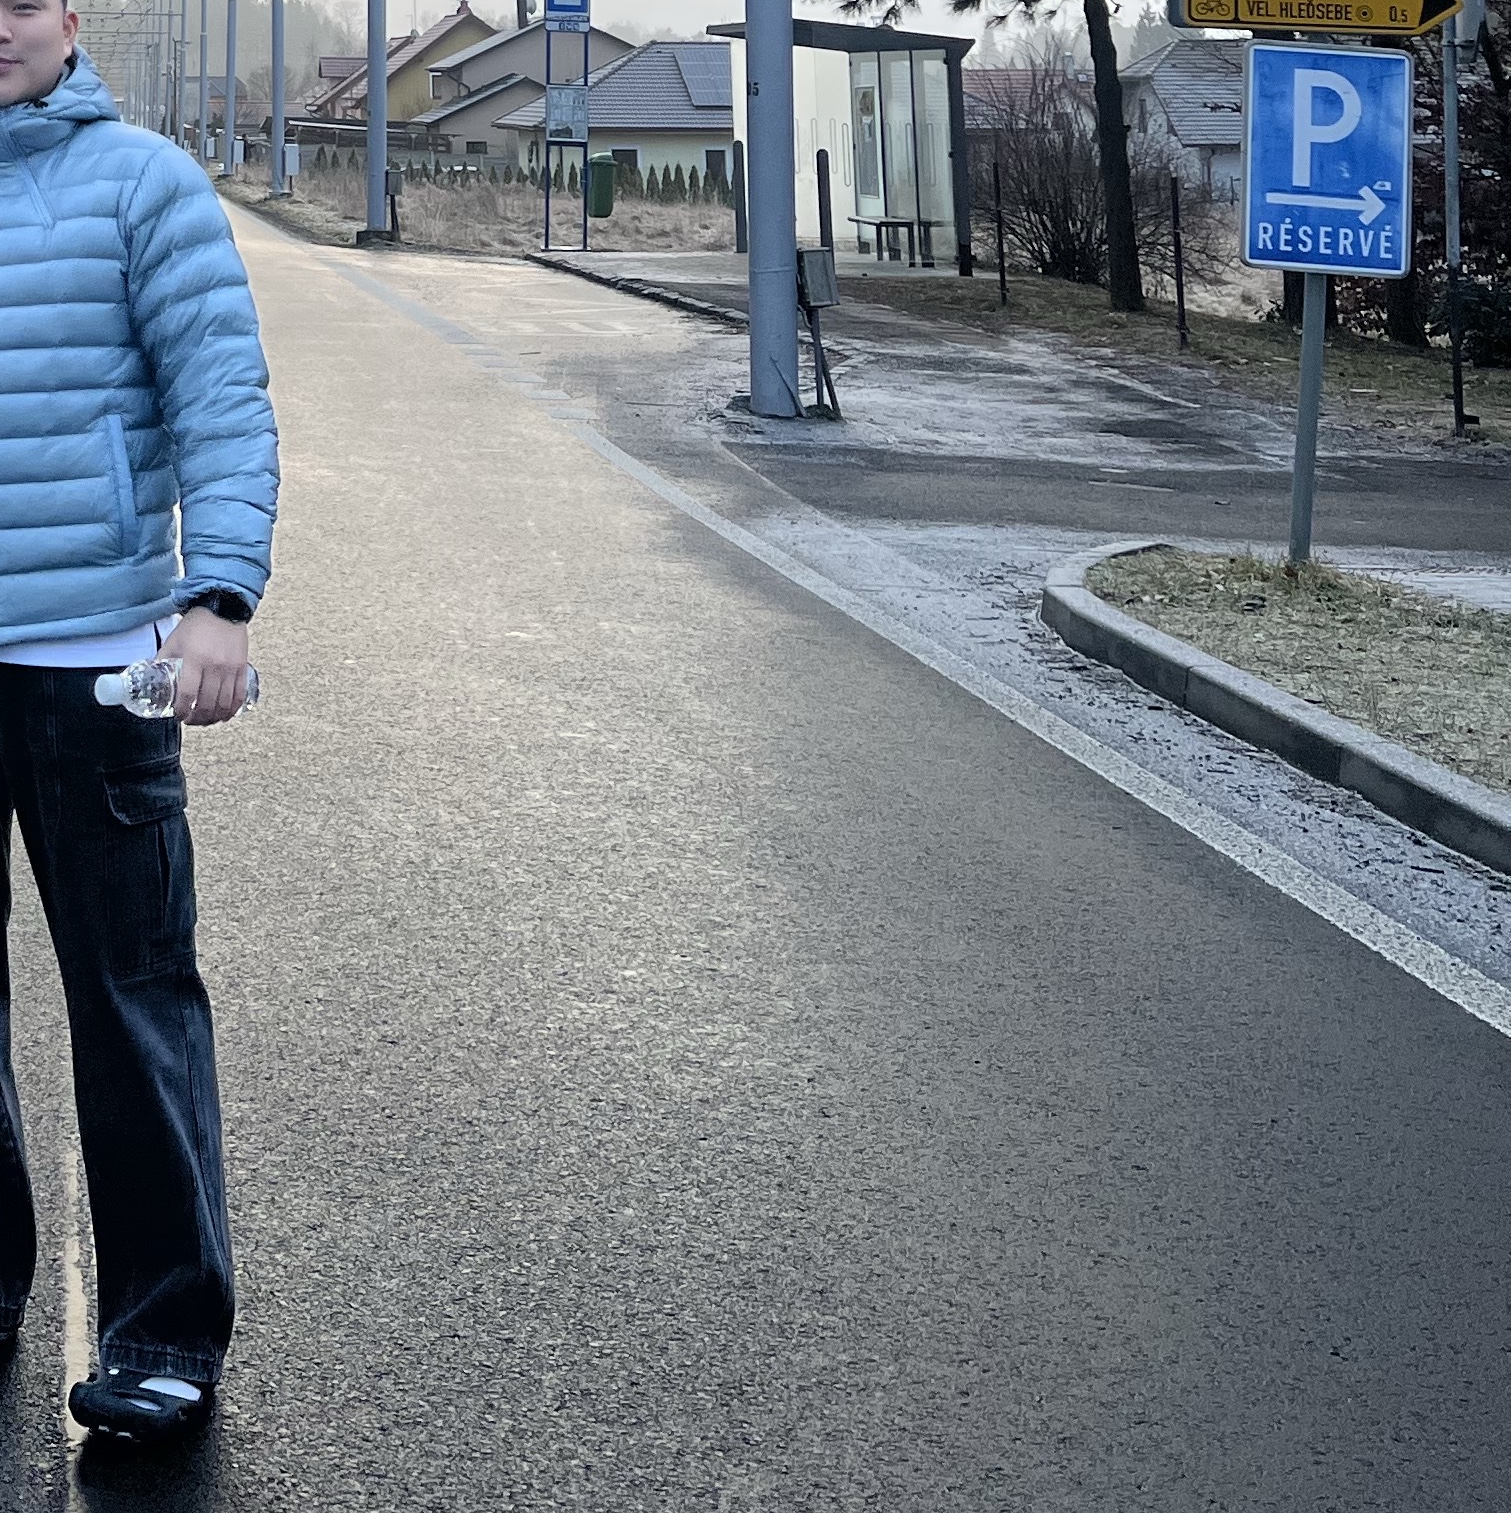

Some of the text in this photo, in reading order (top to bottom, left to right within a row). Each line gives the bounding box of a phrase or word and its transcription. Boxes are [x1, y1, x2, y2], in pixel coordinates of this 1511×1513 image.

[1279, 0, 1354, 22] HLEĎSEBE
[1291, 67, 1363, 188] P
[1257, 217, 1394, 260] RÉSERVÉ
